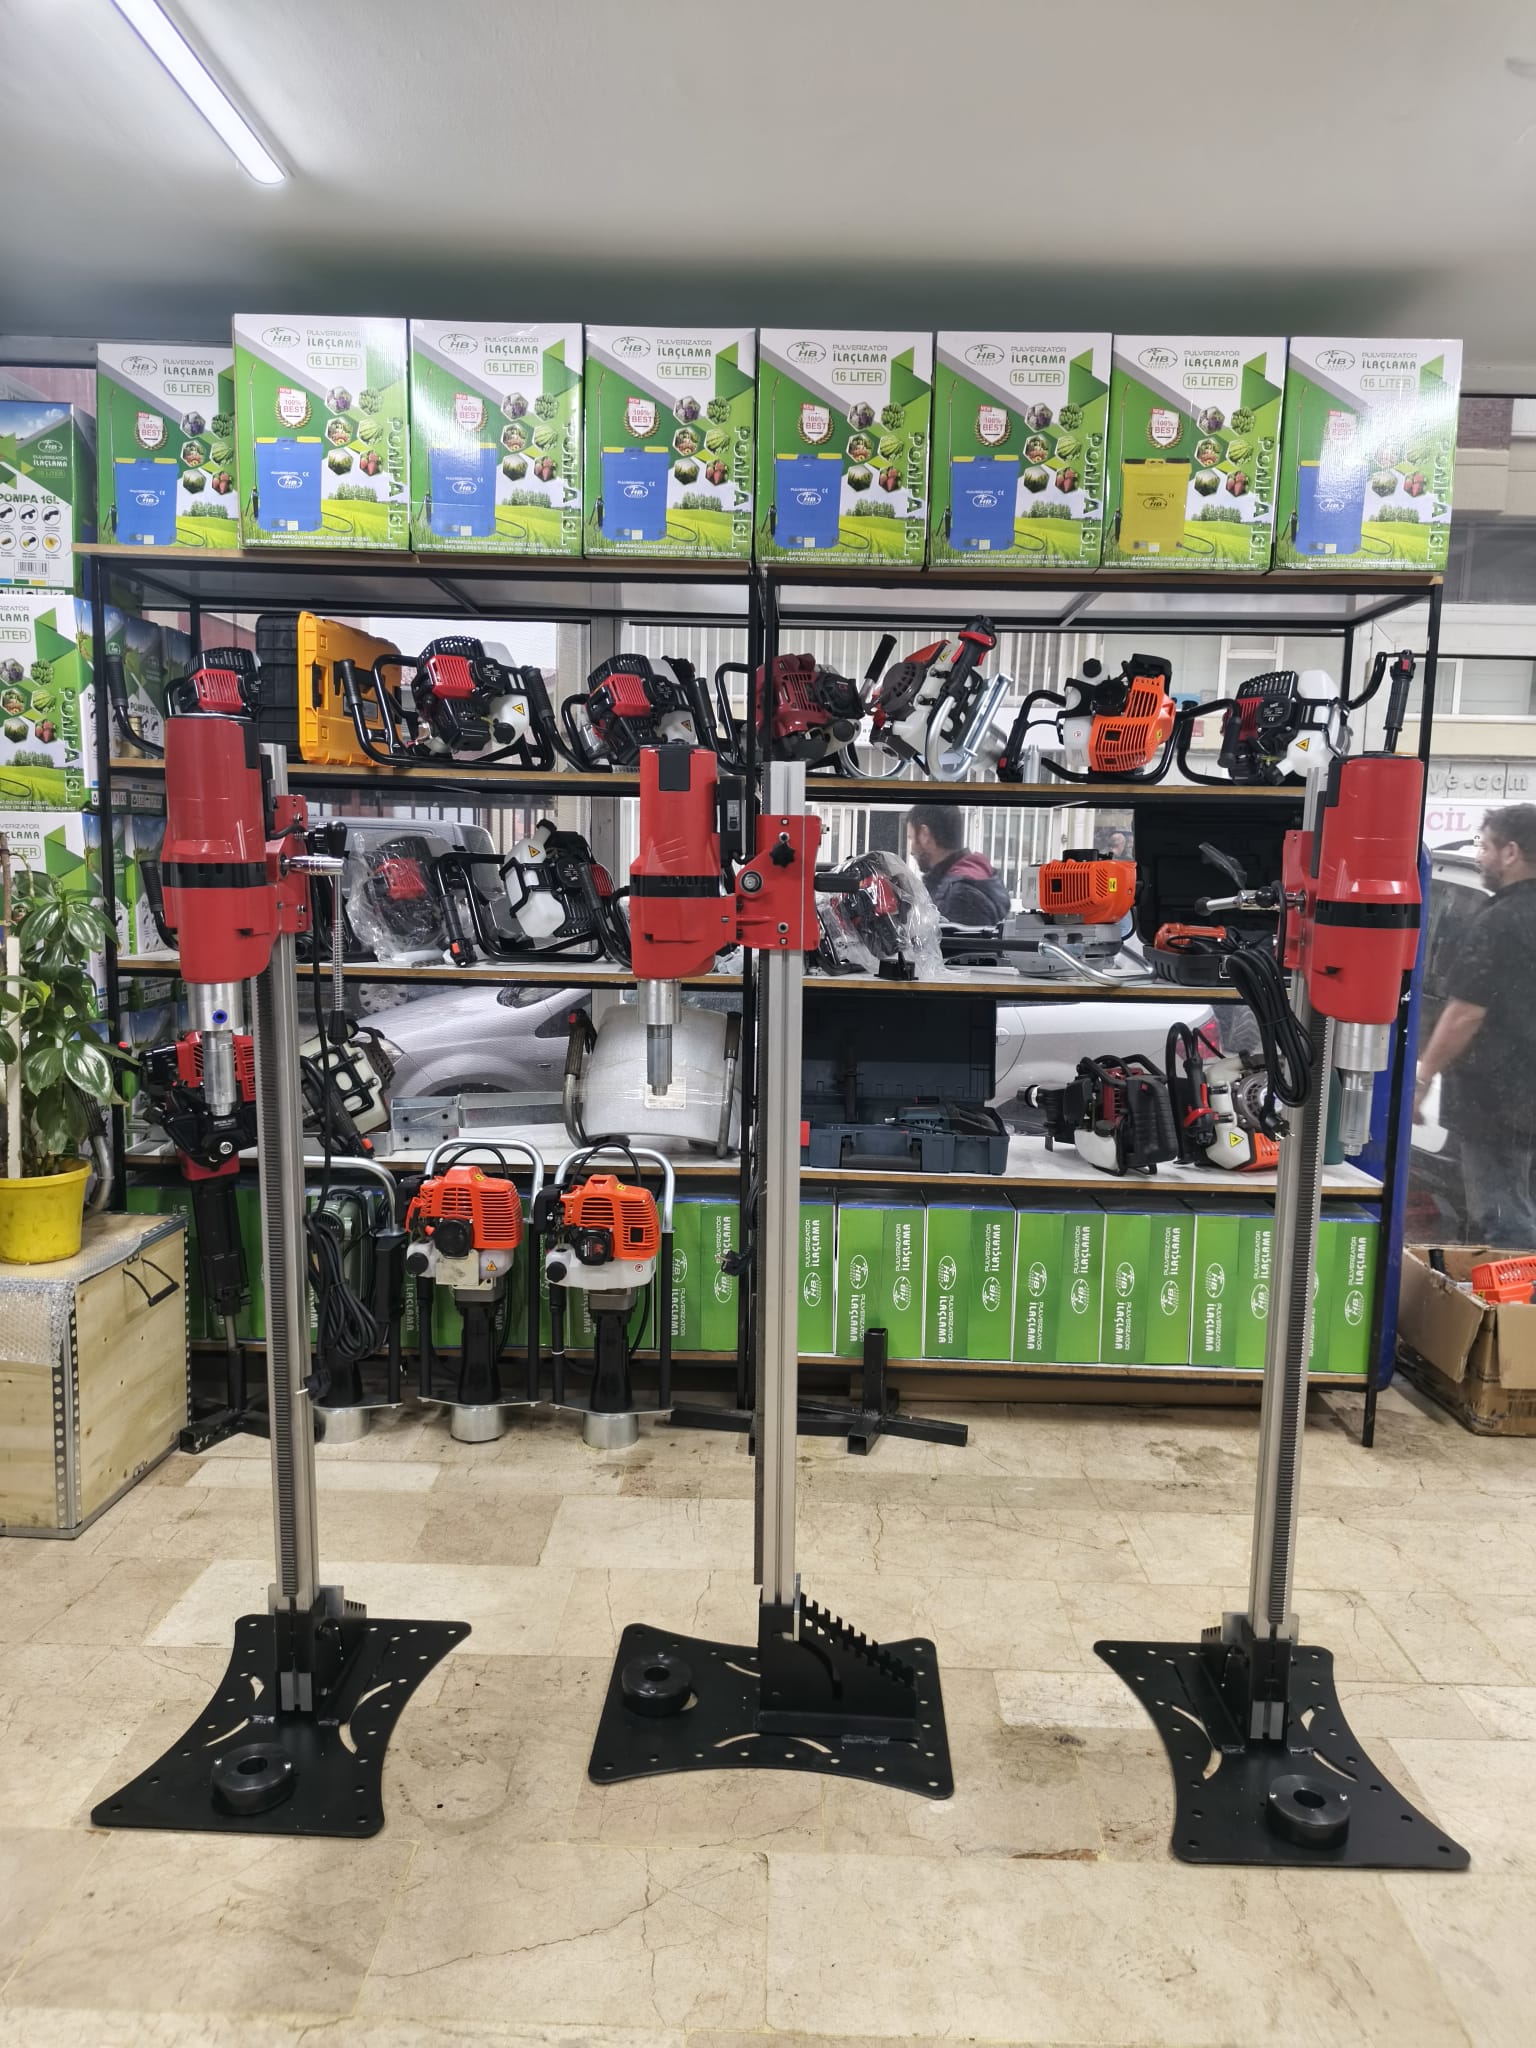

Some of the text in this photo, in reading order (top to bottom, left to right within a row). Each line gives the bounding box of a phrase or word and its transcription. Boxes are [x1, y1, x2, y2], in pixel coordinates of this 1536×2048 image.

[307, 338, 362, 349] İLAÇLAMA
[485, 344, 539, 356] İLAÇLAMA
[657, 347, 712, 359] İLAÇLAMA
[309, 356, 359, 366] 16 LITER
[833, 352, 887, 365] İLAÇLAMA
[1011, 354, 1066, 366] İLAÇLAMA
[1184, 357, 1239, 369] İLAÇLAMA
[163, 366, 214, 377] İLAÇLAMA
[487, 363, 535, 373] 16 LITER
[660, 367, 707, 376] 16 LITER
[1362, 360, 1417, 372] İLAÇLAMA
[835, 373, 883, 383] 16 LITER
[1013, 373, 1061, 383] 16 LITER
[1186, 377, 1233, 387] 16 LITER
[1363, 379, 1375, 387] 16
[166, 384, 211, 394] 16 LITER
[283, 405, 305, 413] BEST
[459, 411, 481, 420] BEST
[631, 415, 653, 423] BEST
[805, 422, 826, 430] BEST
[982, 423, 1004, 432] BEST
[1154, 426, 1176, 434] BEST
[141, 429, 161, 437] BEST
[386, 418, 404, 497] POMPA
[561, 422, 579, 503] POMPA
[733, 426, 750, 506] POMPA
[906, 432, 925, 513] POMPA
[1083, 432, 1103, 514] POMPA
[1254, 436, 1275, 518] POMPA
[812, 1219, 820, 1267] İLAÇLAMA
[902, 1223, 911, 1272] İLAÇLAMA
[991, 1224, 1001, 1272] İLAÇLAMA
[1081, 1226, 1091, 1274] İLAÇLAMA
[1170, 1227, 1181, 1276] İLAÇLAMA
[1356, 1237, 1367, 1286] İLAÇLAMA
[849, 1294, 859, 1342] İLAÇLAMA
[938, 1295, 946, 1344] İLAÇLAMA
[1027, 1302, 1037, 1350] İLAÇLAMA
[1114, 1302, 1124, 1350] İLAÇLAMA
[1205, 1303, 1215, 1352] İLAÇLAMA
